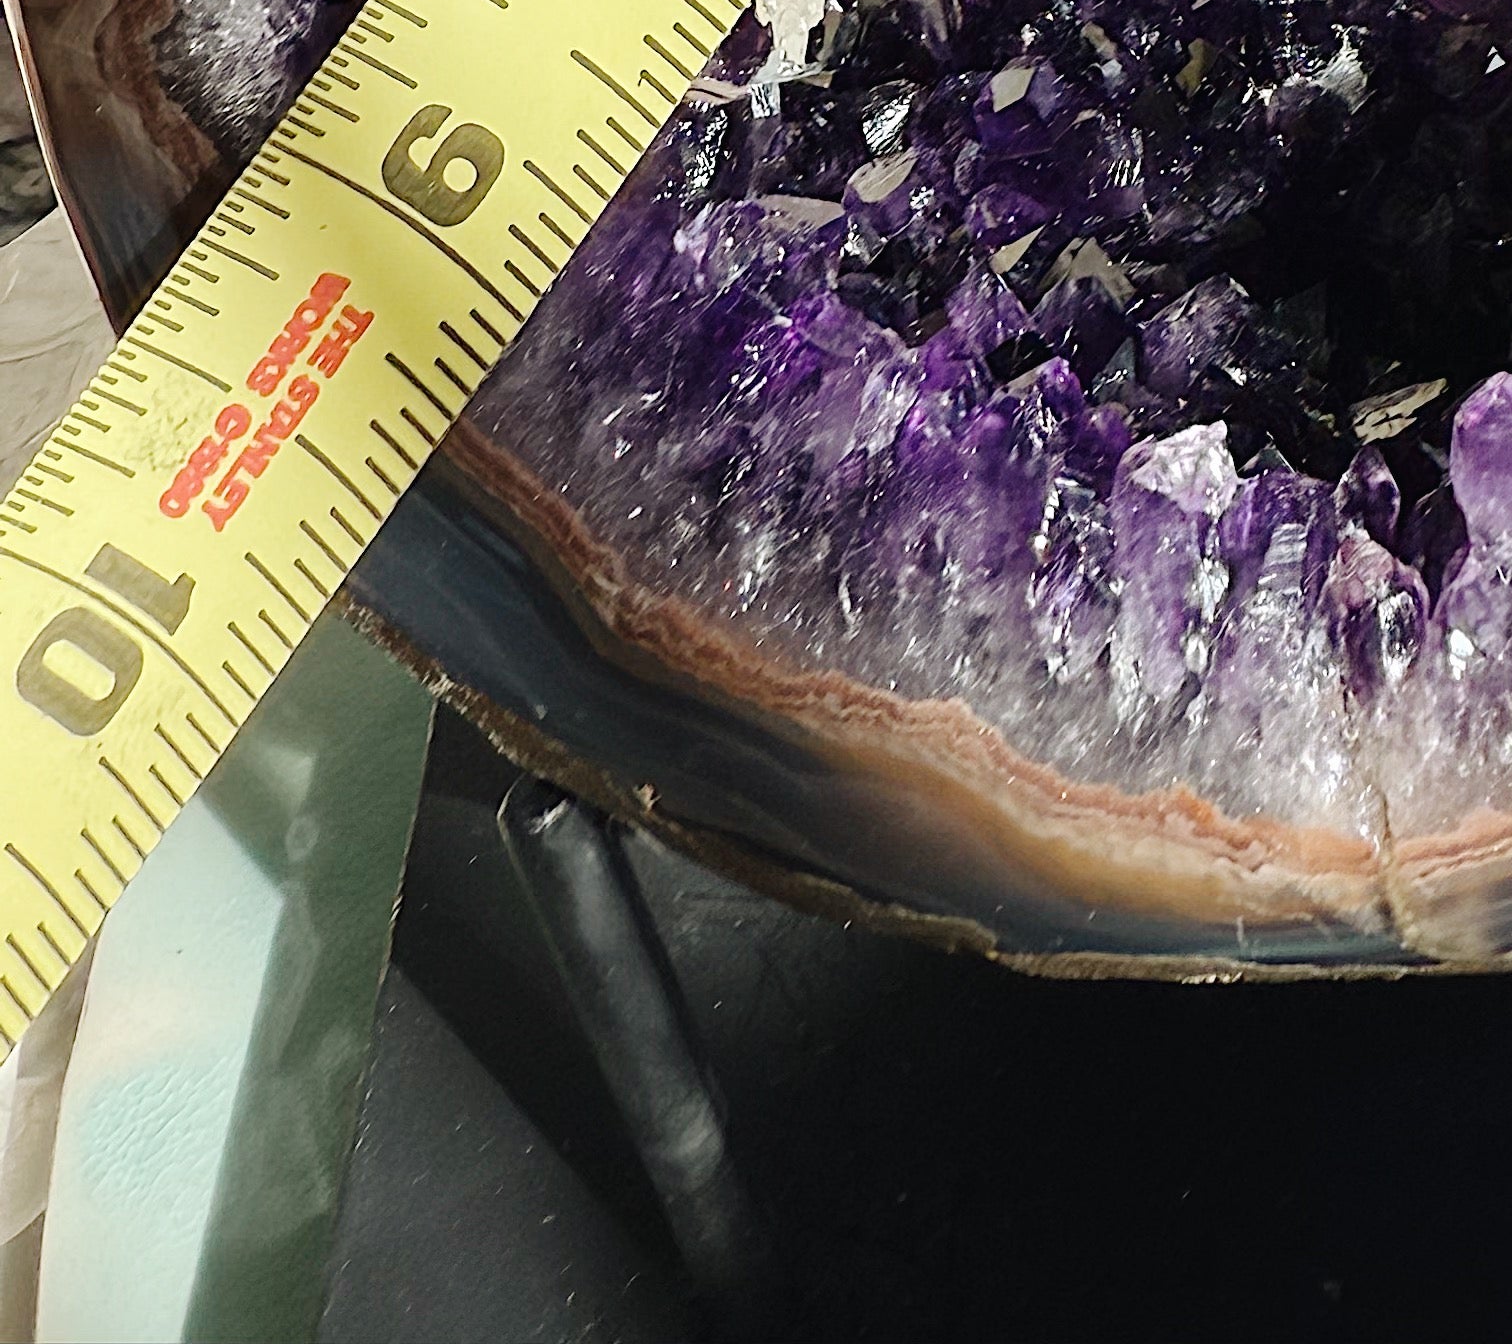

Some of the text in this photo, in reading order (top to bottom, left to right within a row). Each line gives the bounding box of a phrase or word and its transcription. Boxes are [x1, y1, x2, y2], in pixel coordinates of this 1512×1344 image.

[380, 103, 505, 227] 9
[246, 272, 352, 397] WORKS
[201, 304, 375, 533] THE STANLEY
[15, 543, 196, 737] 10
